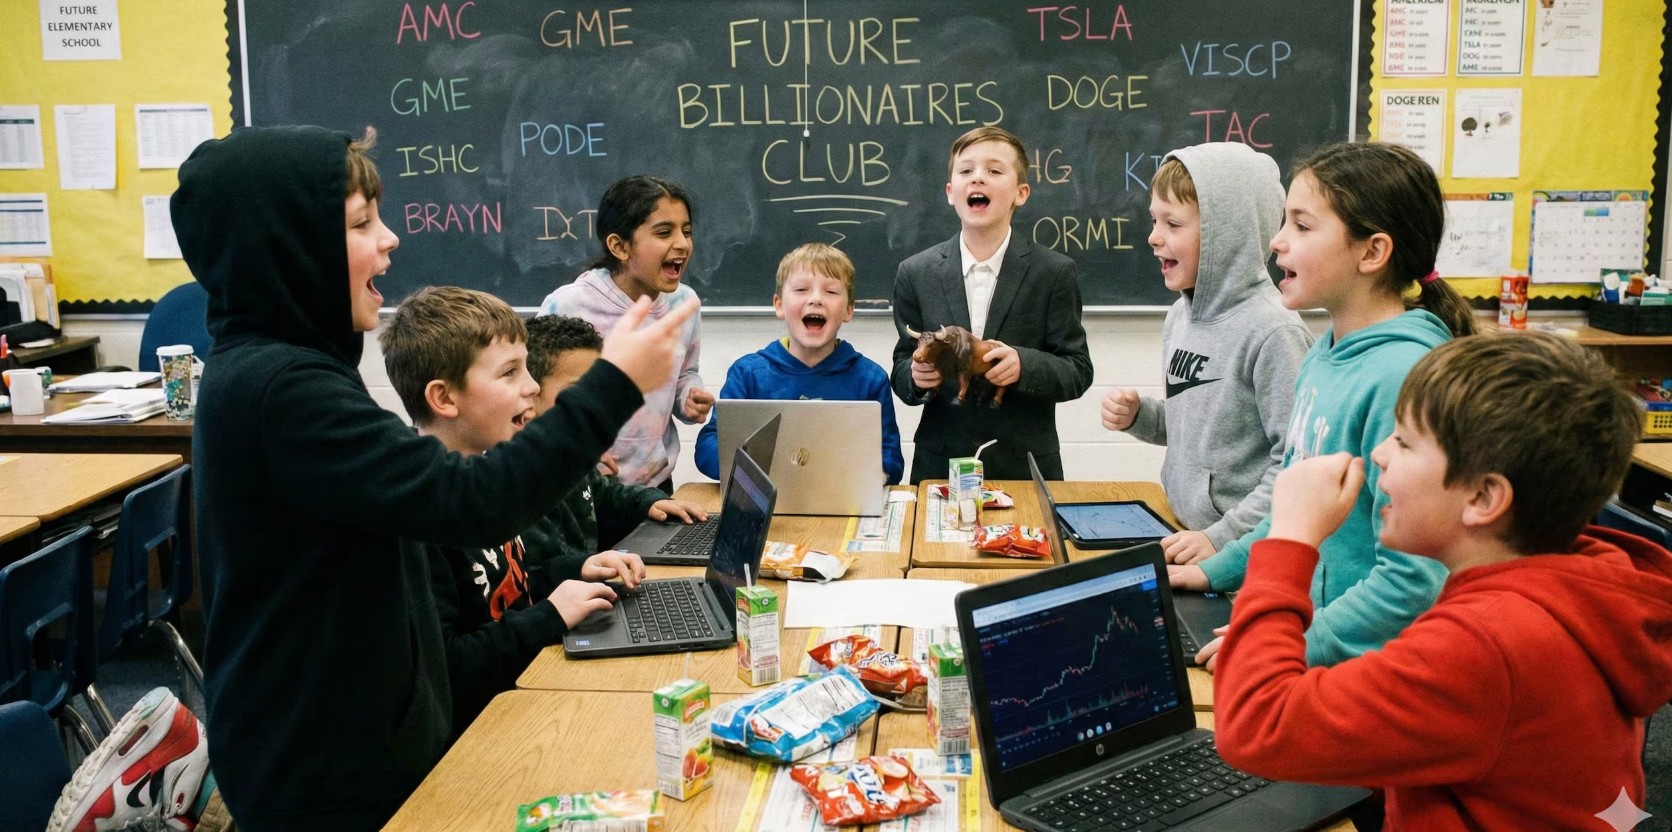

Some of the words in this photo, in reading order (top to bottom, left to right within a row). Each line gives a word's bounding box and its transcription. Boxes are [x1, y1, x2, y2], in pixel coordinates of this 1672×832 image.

[48, 22, 113, 32] ELEMENTARY
[59, 6, 98, 15] FUTURE
[397, 1, 482, 44] AMC
[540, 8, 634, 49] GME
[1026, 4, 1133, 42] TSLA
[61, 38, 102, 47] SCHOOL
[729, 16, 921, 68] FUTURE
[1180, 40, 1292, 79] VISCP
[391, 77, 471, 117] GME
[677, 80, 1005, 129] BILLIONAIRES
[1047, 74, 1149, 111] DOGE
[1386, 95, 1415, 105] DOGE
[1418, 96, 1440, 105] REN
[519, 121, 607, 157] PODE
[1190, 109, 1273, 148] TAC
[396, 143, 479, 177] ISHC
[762, 139, 891, 187] CLUB
[404, 201, 503, 235] BRAYN
[1033, 216, 1134, 252] ORMI
[1168, 348, 1210, 381] NIKE
